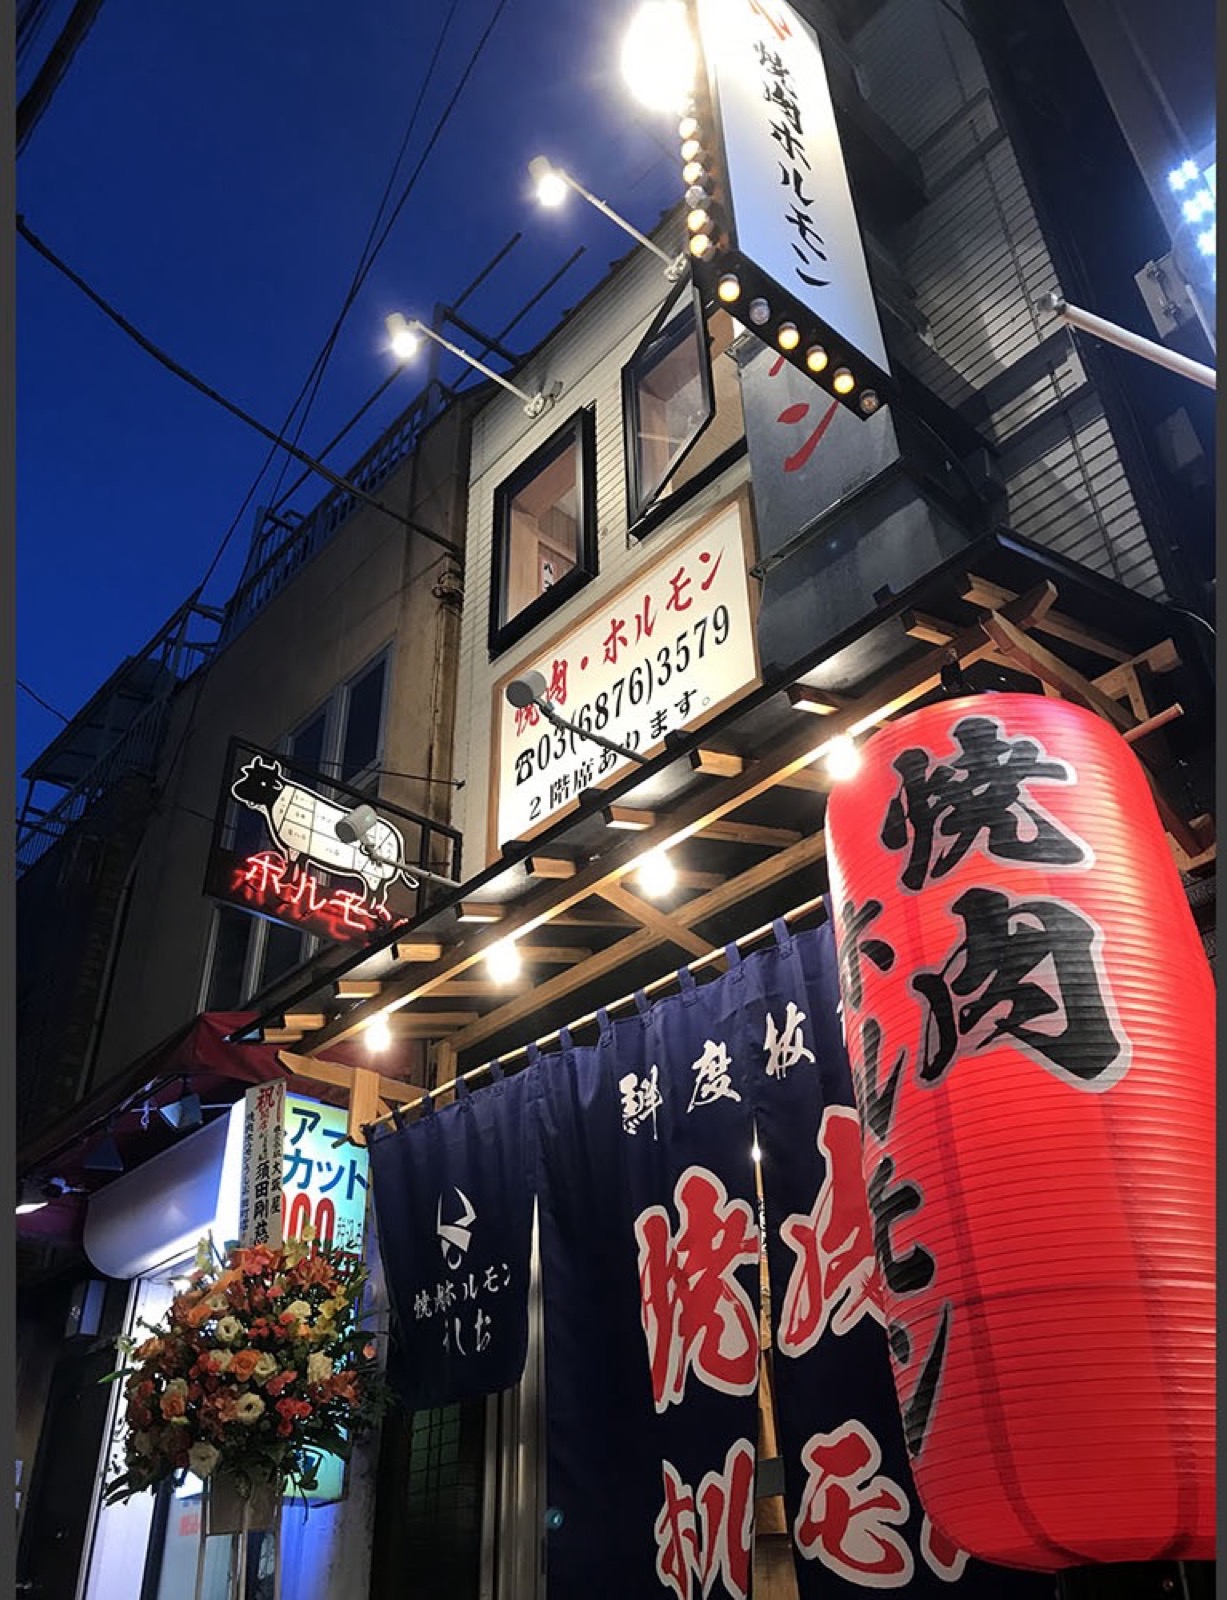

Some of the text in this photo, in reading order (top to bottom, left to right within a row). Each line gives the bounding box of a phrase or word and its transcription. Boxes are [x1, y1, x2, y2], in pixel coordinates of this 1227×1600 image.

[880, 716, 1132, 1090] 焼肉
[618, 1000, 849, 1142] 鮮度抜
[282, 1148, 369, 1201] カット
[284, 1106, 350, 1147] アー
[280, 1192, 335, 1258] 00
[653, 1418, 972, 1600] ホルモ
